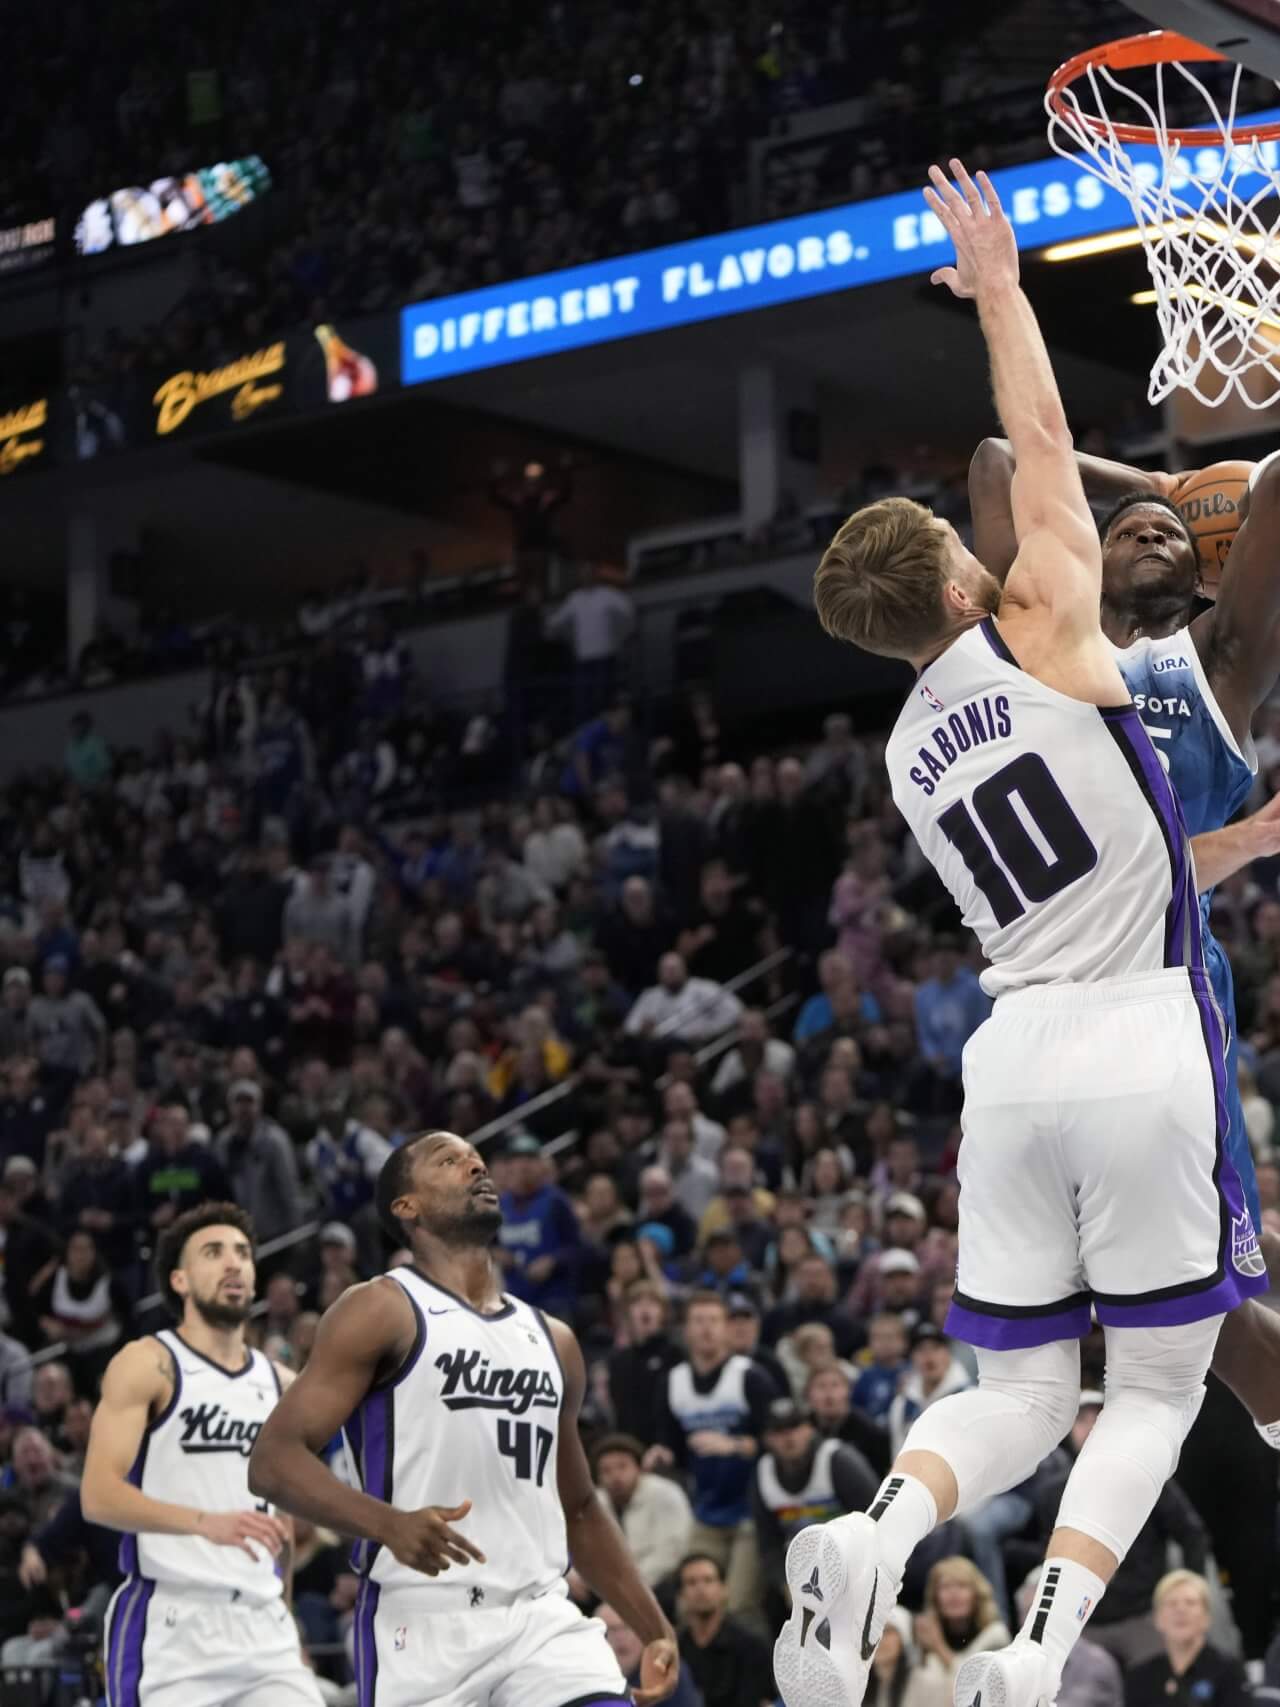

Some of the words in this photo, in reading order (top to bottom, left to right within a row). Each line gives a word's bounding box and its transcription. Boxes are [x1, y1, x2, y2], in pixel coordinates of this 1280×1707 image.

[414, 277, 640, 359] DIFFERENT
[662, 230, 868, 304] FLAVORS.
[893, 178, 1105, 252] ENESS
[1181, 492, 1240, 524] Wils
[909, 695, 1012, 796] SABONIS
[936, 752, 1098, 929] 10
[434, 1348, 558, 1415] Kings
[497, 1418, 554, 1487] 47
